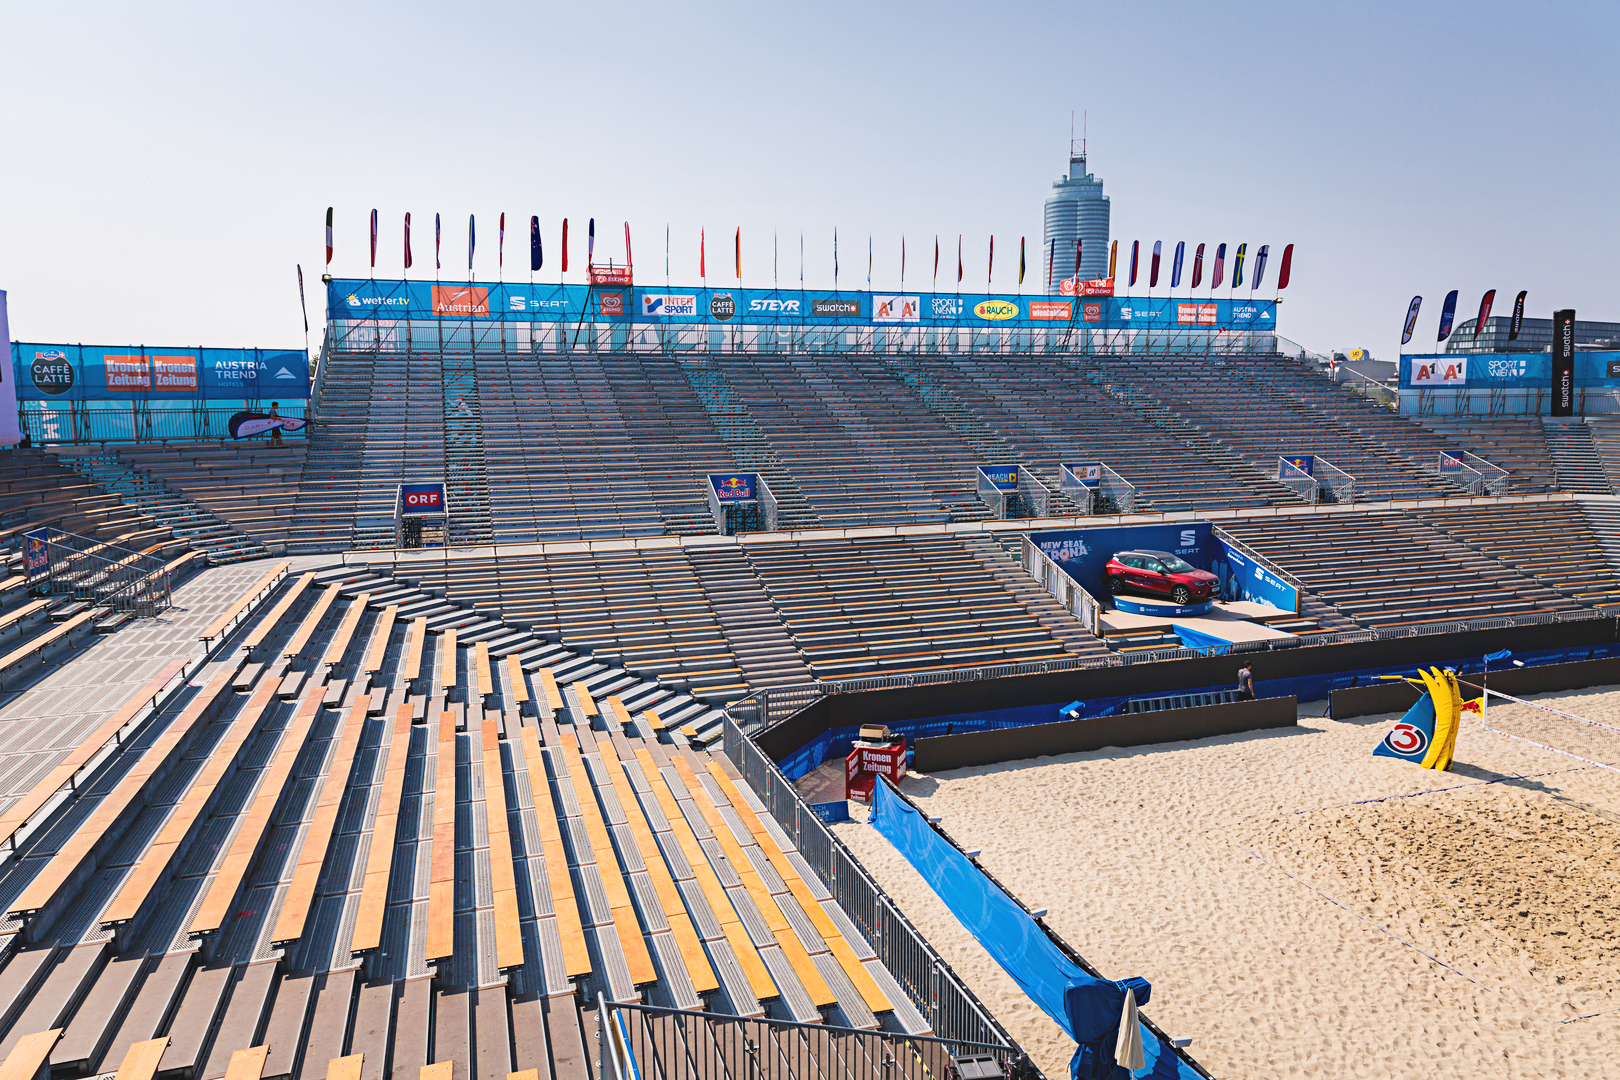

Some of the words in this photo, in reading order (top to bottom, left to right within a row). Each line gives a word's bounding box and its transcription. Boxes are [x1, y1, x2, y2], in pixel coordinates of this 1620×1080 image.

[362, 296, 410, 305] wetter.tv
[530, 299, 569, 308] SEAT
[664, 297, 693, 306] INTER
[749, 300, 800, 311] STEYR
[931, 298, 957, 307] SPORT
[437, 301, 485, 313] Austrian
[664, 305, 693, 314] SPORT
[816, 303, 851, 312] swatch
[877, 300, 893, 317] A1
[901, 300, 917, 317] A1
[931, 306, 952, 314] WIEN
[986, 306, 1013, 315] RAUCH
[1178, 305, 1197, 314] Kronen
[1198, 306, 1217, 314] Kronen
[1032, 309, 1069, 318] wienholding
[1514, 303, 1522, 333] swatch
[1562, 325, 1571, 358] swatch
[33, 363, 71, 375] CAFFÈ
[106, 359, 149, 373] Kronen
[154, 360, 195, 373] Kronen
[215, 360, 268, 371] AUSTRIA
[1488, 360, 1518, 369] SPORT
[215, 370, 258, 379] TREND
[1416, 362, 1435, 381] A1
[1443, 362, 1462, 381] A1
[1488, 368, 1512, 377] WIEN
[34, 374, 71, 383] LATTE
[107, 373, 151, 387] Zeitung
[155, 373, 196, 387] Zeitung
[1560, 374, 1570, 408] swatch
[718, 489, 734, 498] Red
[735, 488, 750, 497] Bull
[408, 494, 438, 504] ORF
[1040, 541, 1062, 550] NEW
[1062, 539, 1084, 548] SEAT
[1174, 547, 1200, 555] SEAT
[1264, 575, 1287, 592] SEAT
[862, 750, 892, 763] Kronen
[862, 761, 892, 775] Zeitung
